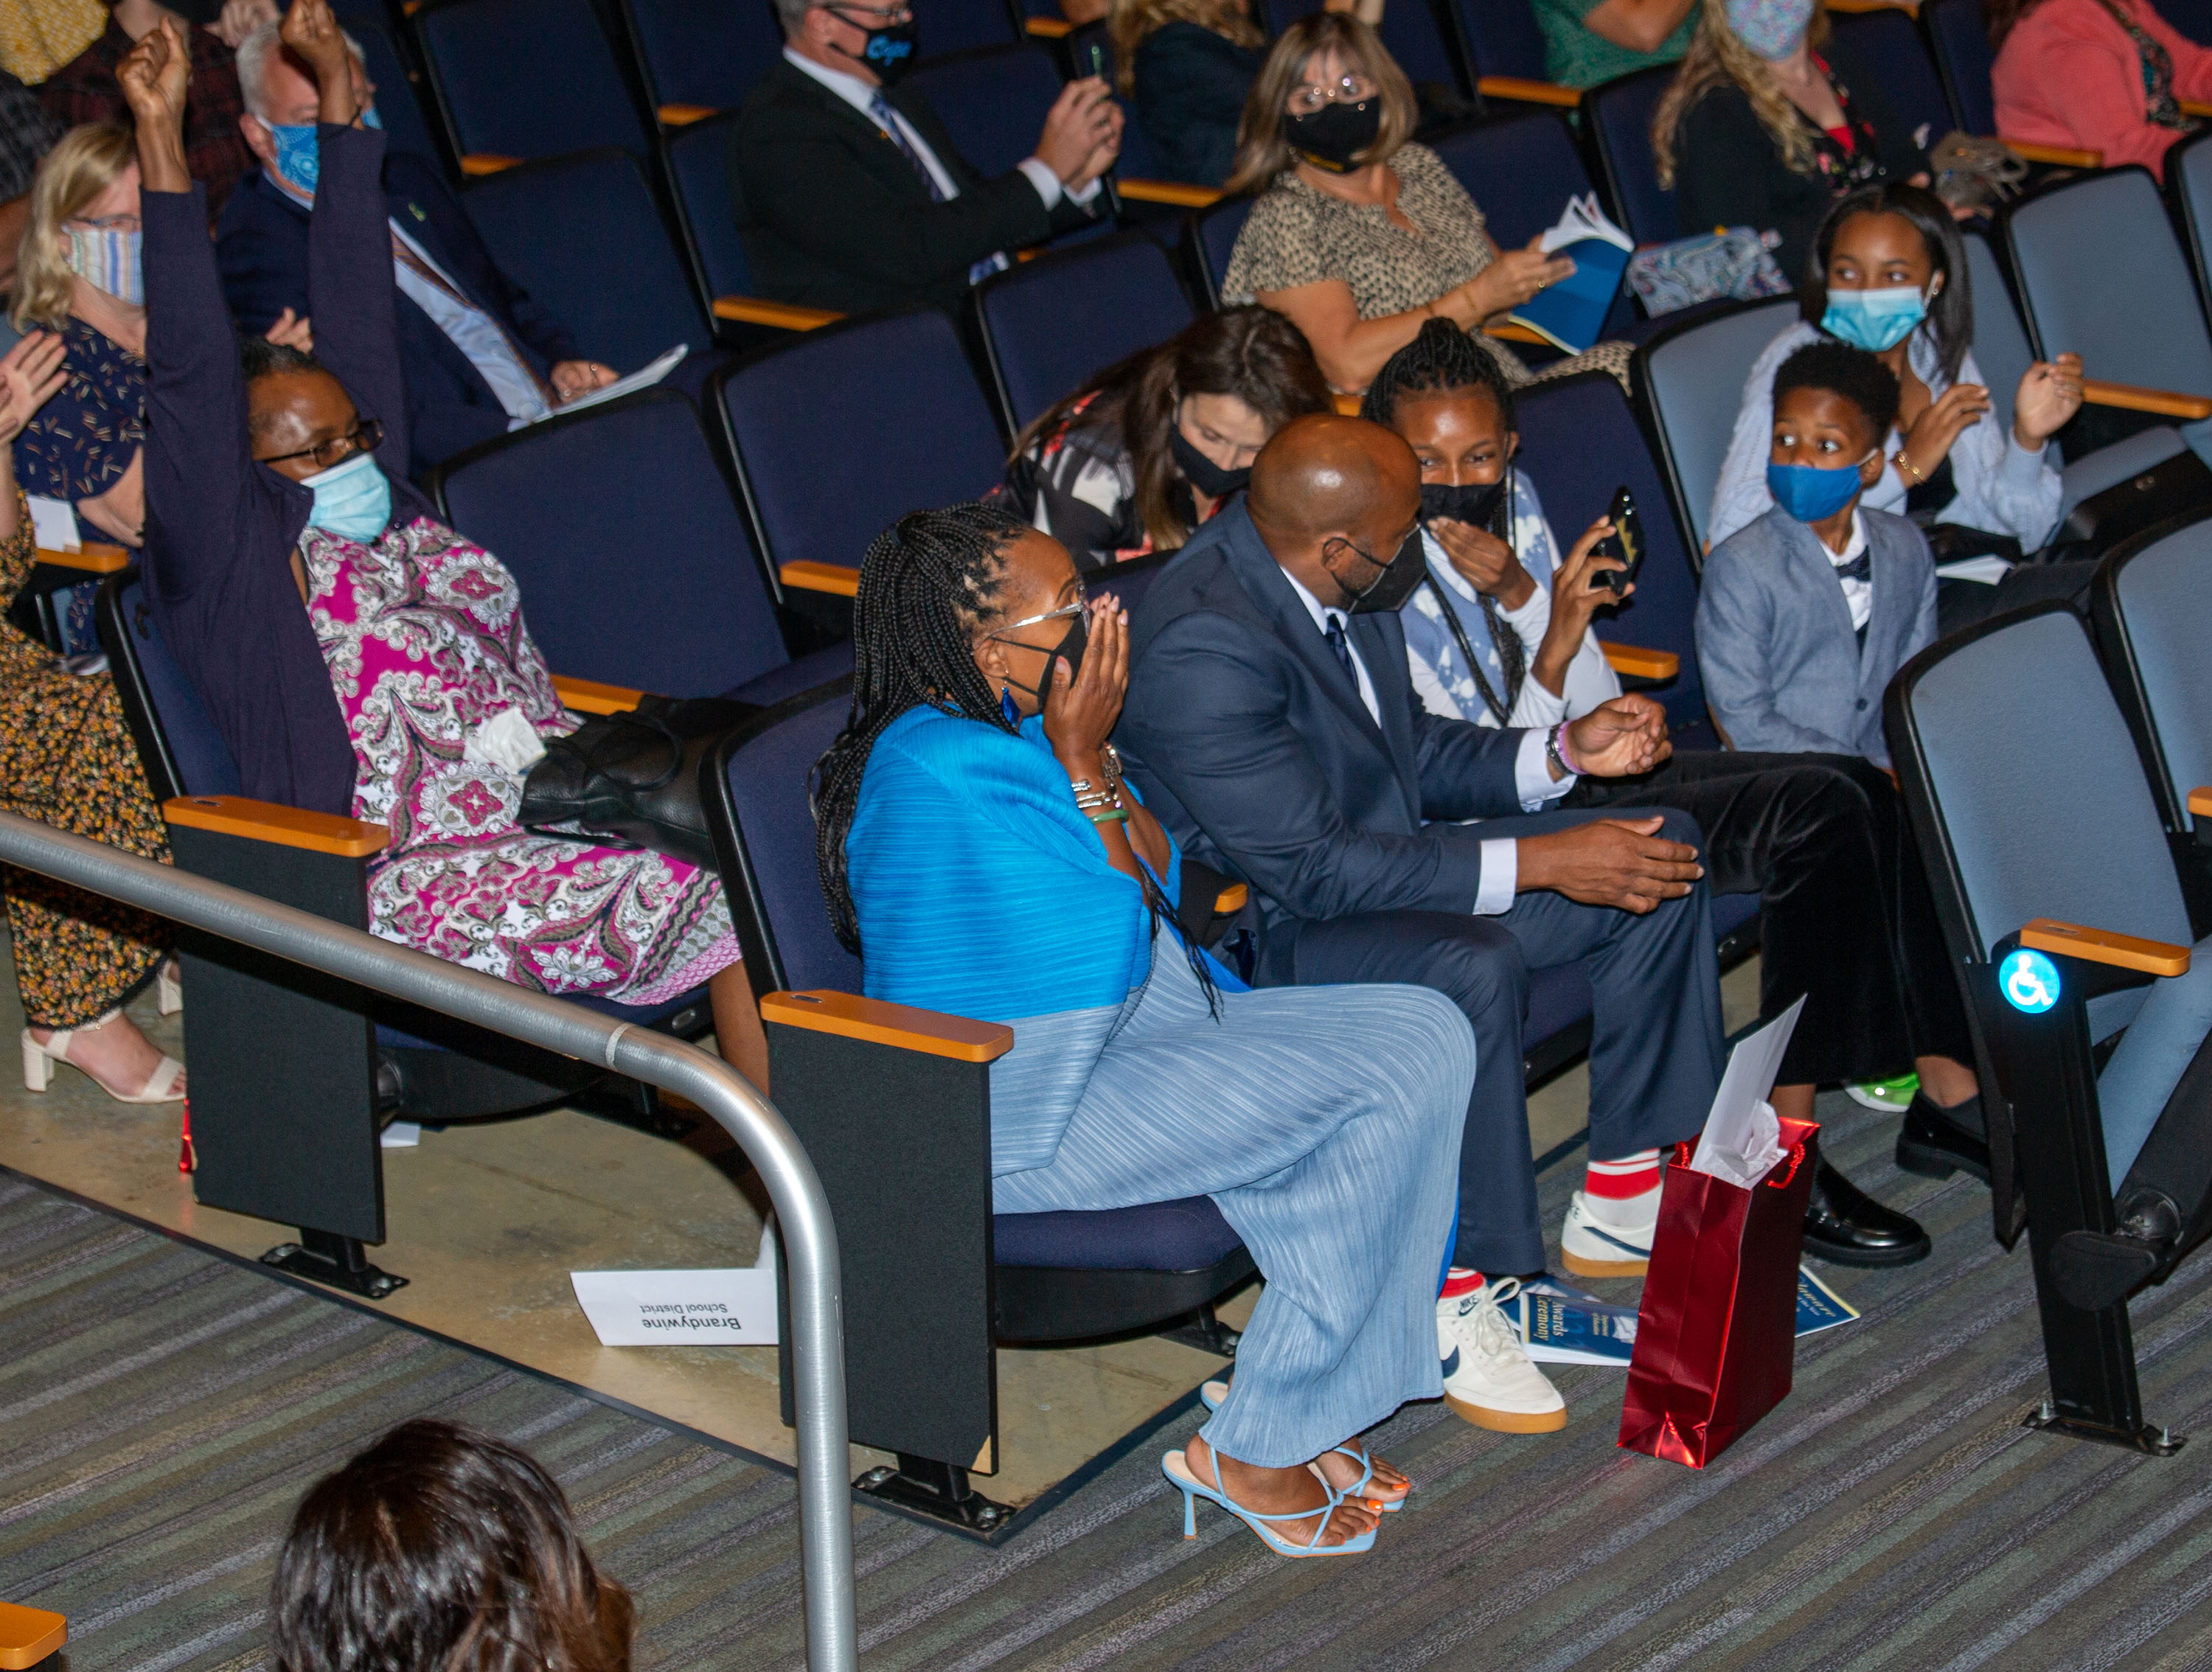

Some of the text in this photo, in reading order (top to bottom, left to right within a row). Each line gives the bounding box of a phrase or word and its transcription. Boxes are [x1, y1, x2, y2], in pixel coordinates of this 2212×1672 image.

[639, 1303, 728, 1314] School District
[1460, 1294, 1478, 1310] NIKE
[641, 1316, 742, 1330] Brandywine
[1534, 1295, 1552, 1341] Ceremony
[1552, 1302, 1569, 1337] Awards
